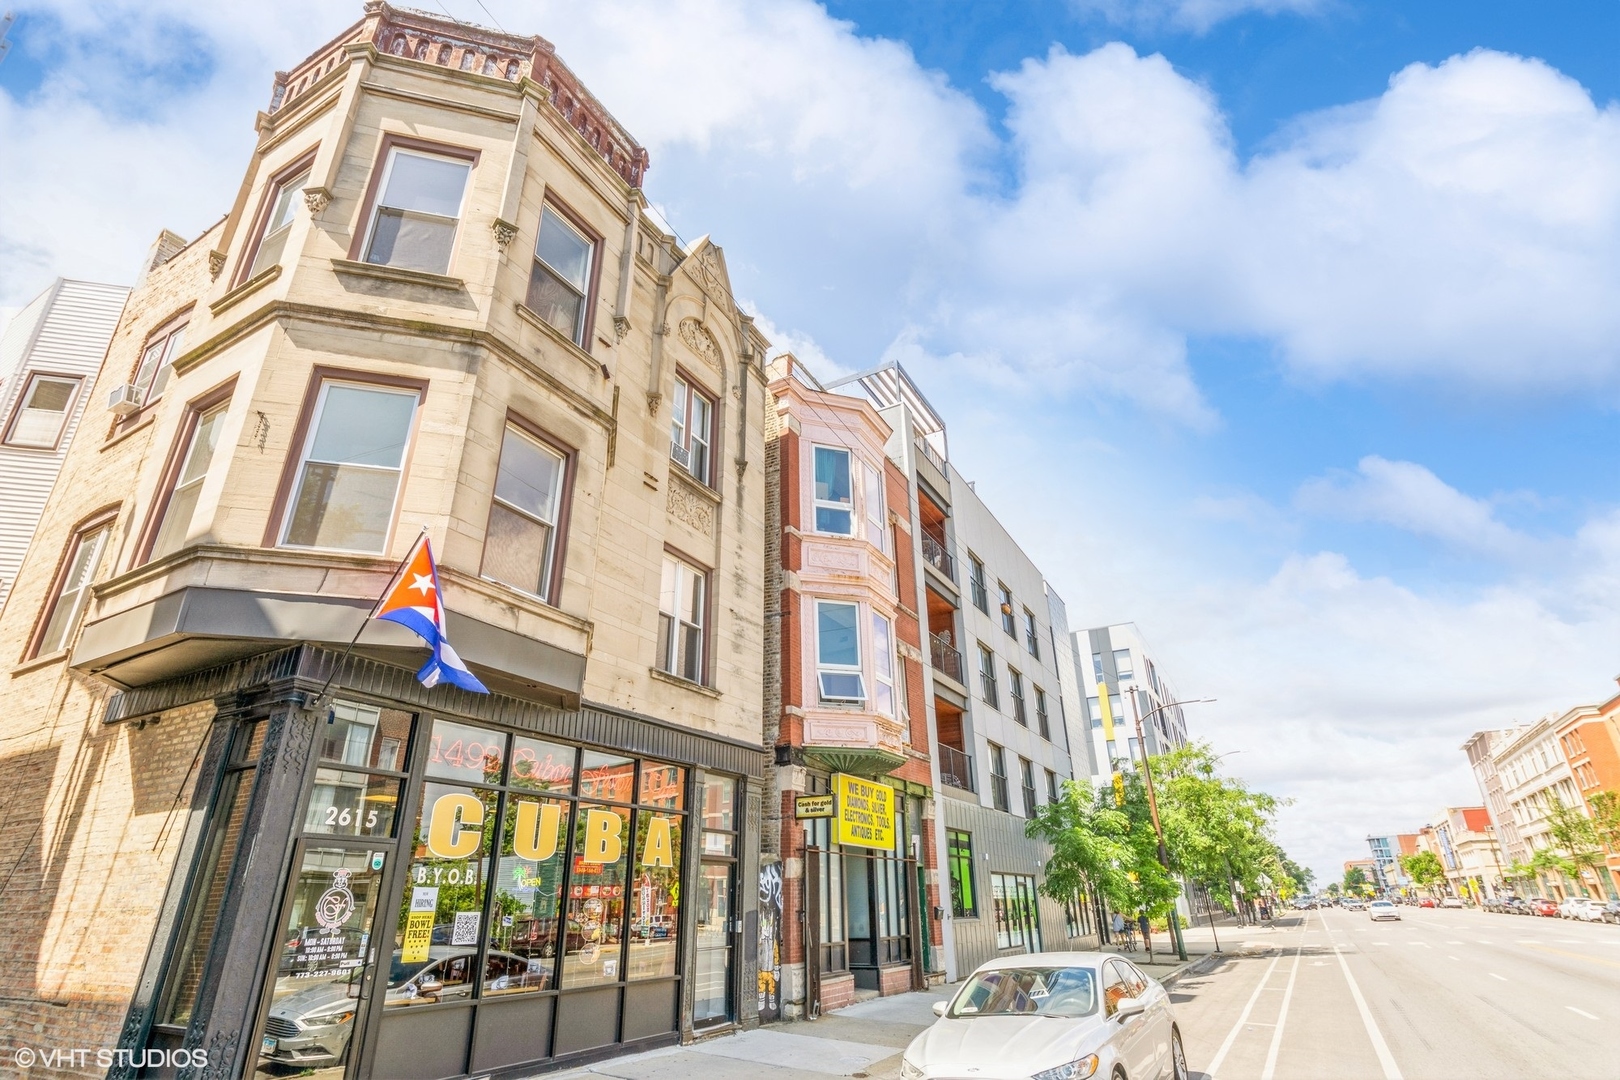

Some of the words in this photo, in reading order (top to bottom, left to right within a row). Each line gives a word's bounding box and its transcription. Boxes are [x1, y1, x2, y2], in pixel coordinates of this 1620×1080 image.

[431, 733, 501, 773] 1492
[511, 747, 572, 784] Cuban
[848, 781, 859, 795] WE
[860, 785, 874, 799] BUY
[875, 789, 886, 802] GOLD
[325, 806, 378, 828] 2615
[851, 825, 872, 839] ANTIQUES
[521, 877, 541, 887] OPEN
[414, 898, 434, 908] HIRING
[409, 919, 431, 929] BOWL
[407, 929, 430, 939] FREE!
[320, 937, 346, 946] SATURDAY
